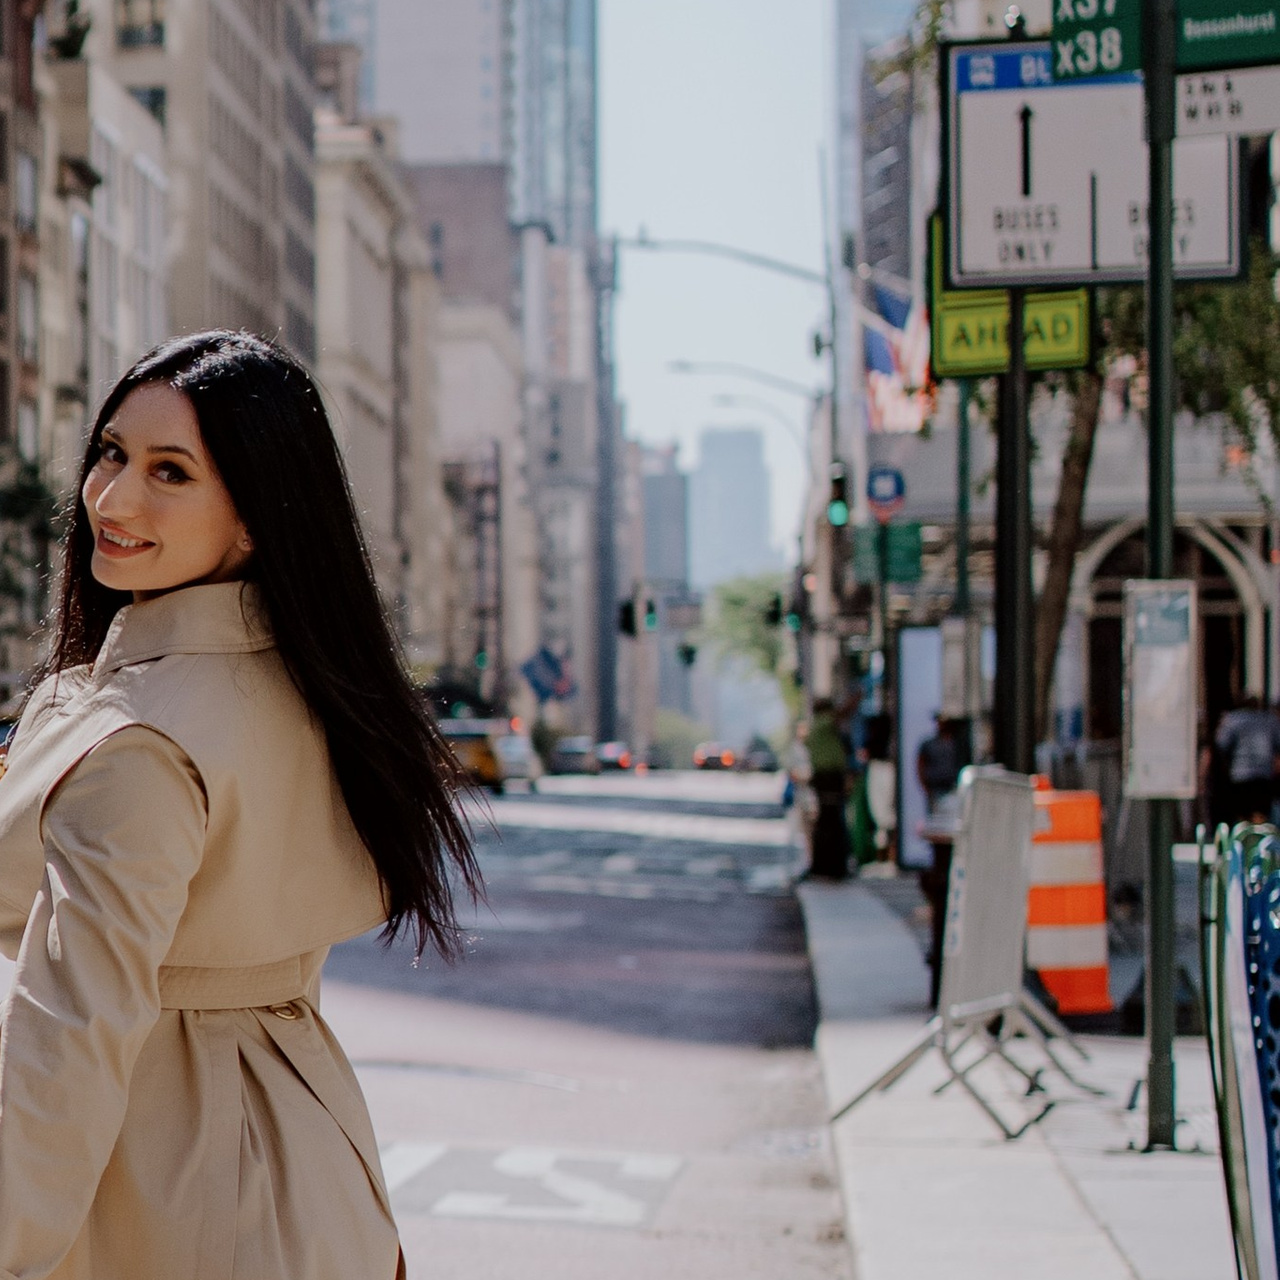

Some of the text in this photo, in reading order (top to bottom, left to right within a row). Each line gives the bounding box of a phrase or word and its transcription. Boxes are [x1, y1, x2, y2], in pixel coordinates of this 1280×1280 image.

[993, 203, 1060, 232] BUSES
[997, 241, 1054, 264] ONLY
[951, 311, 1073, 351] AHAD
